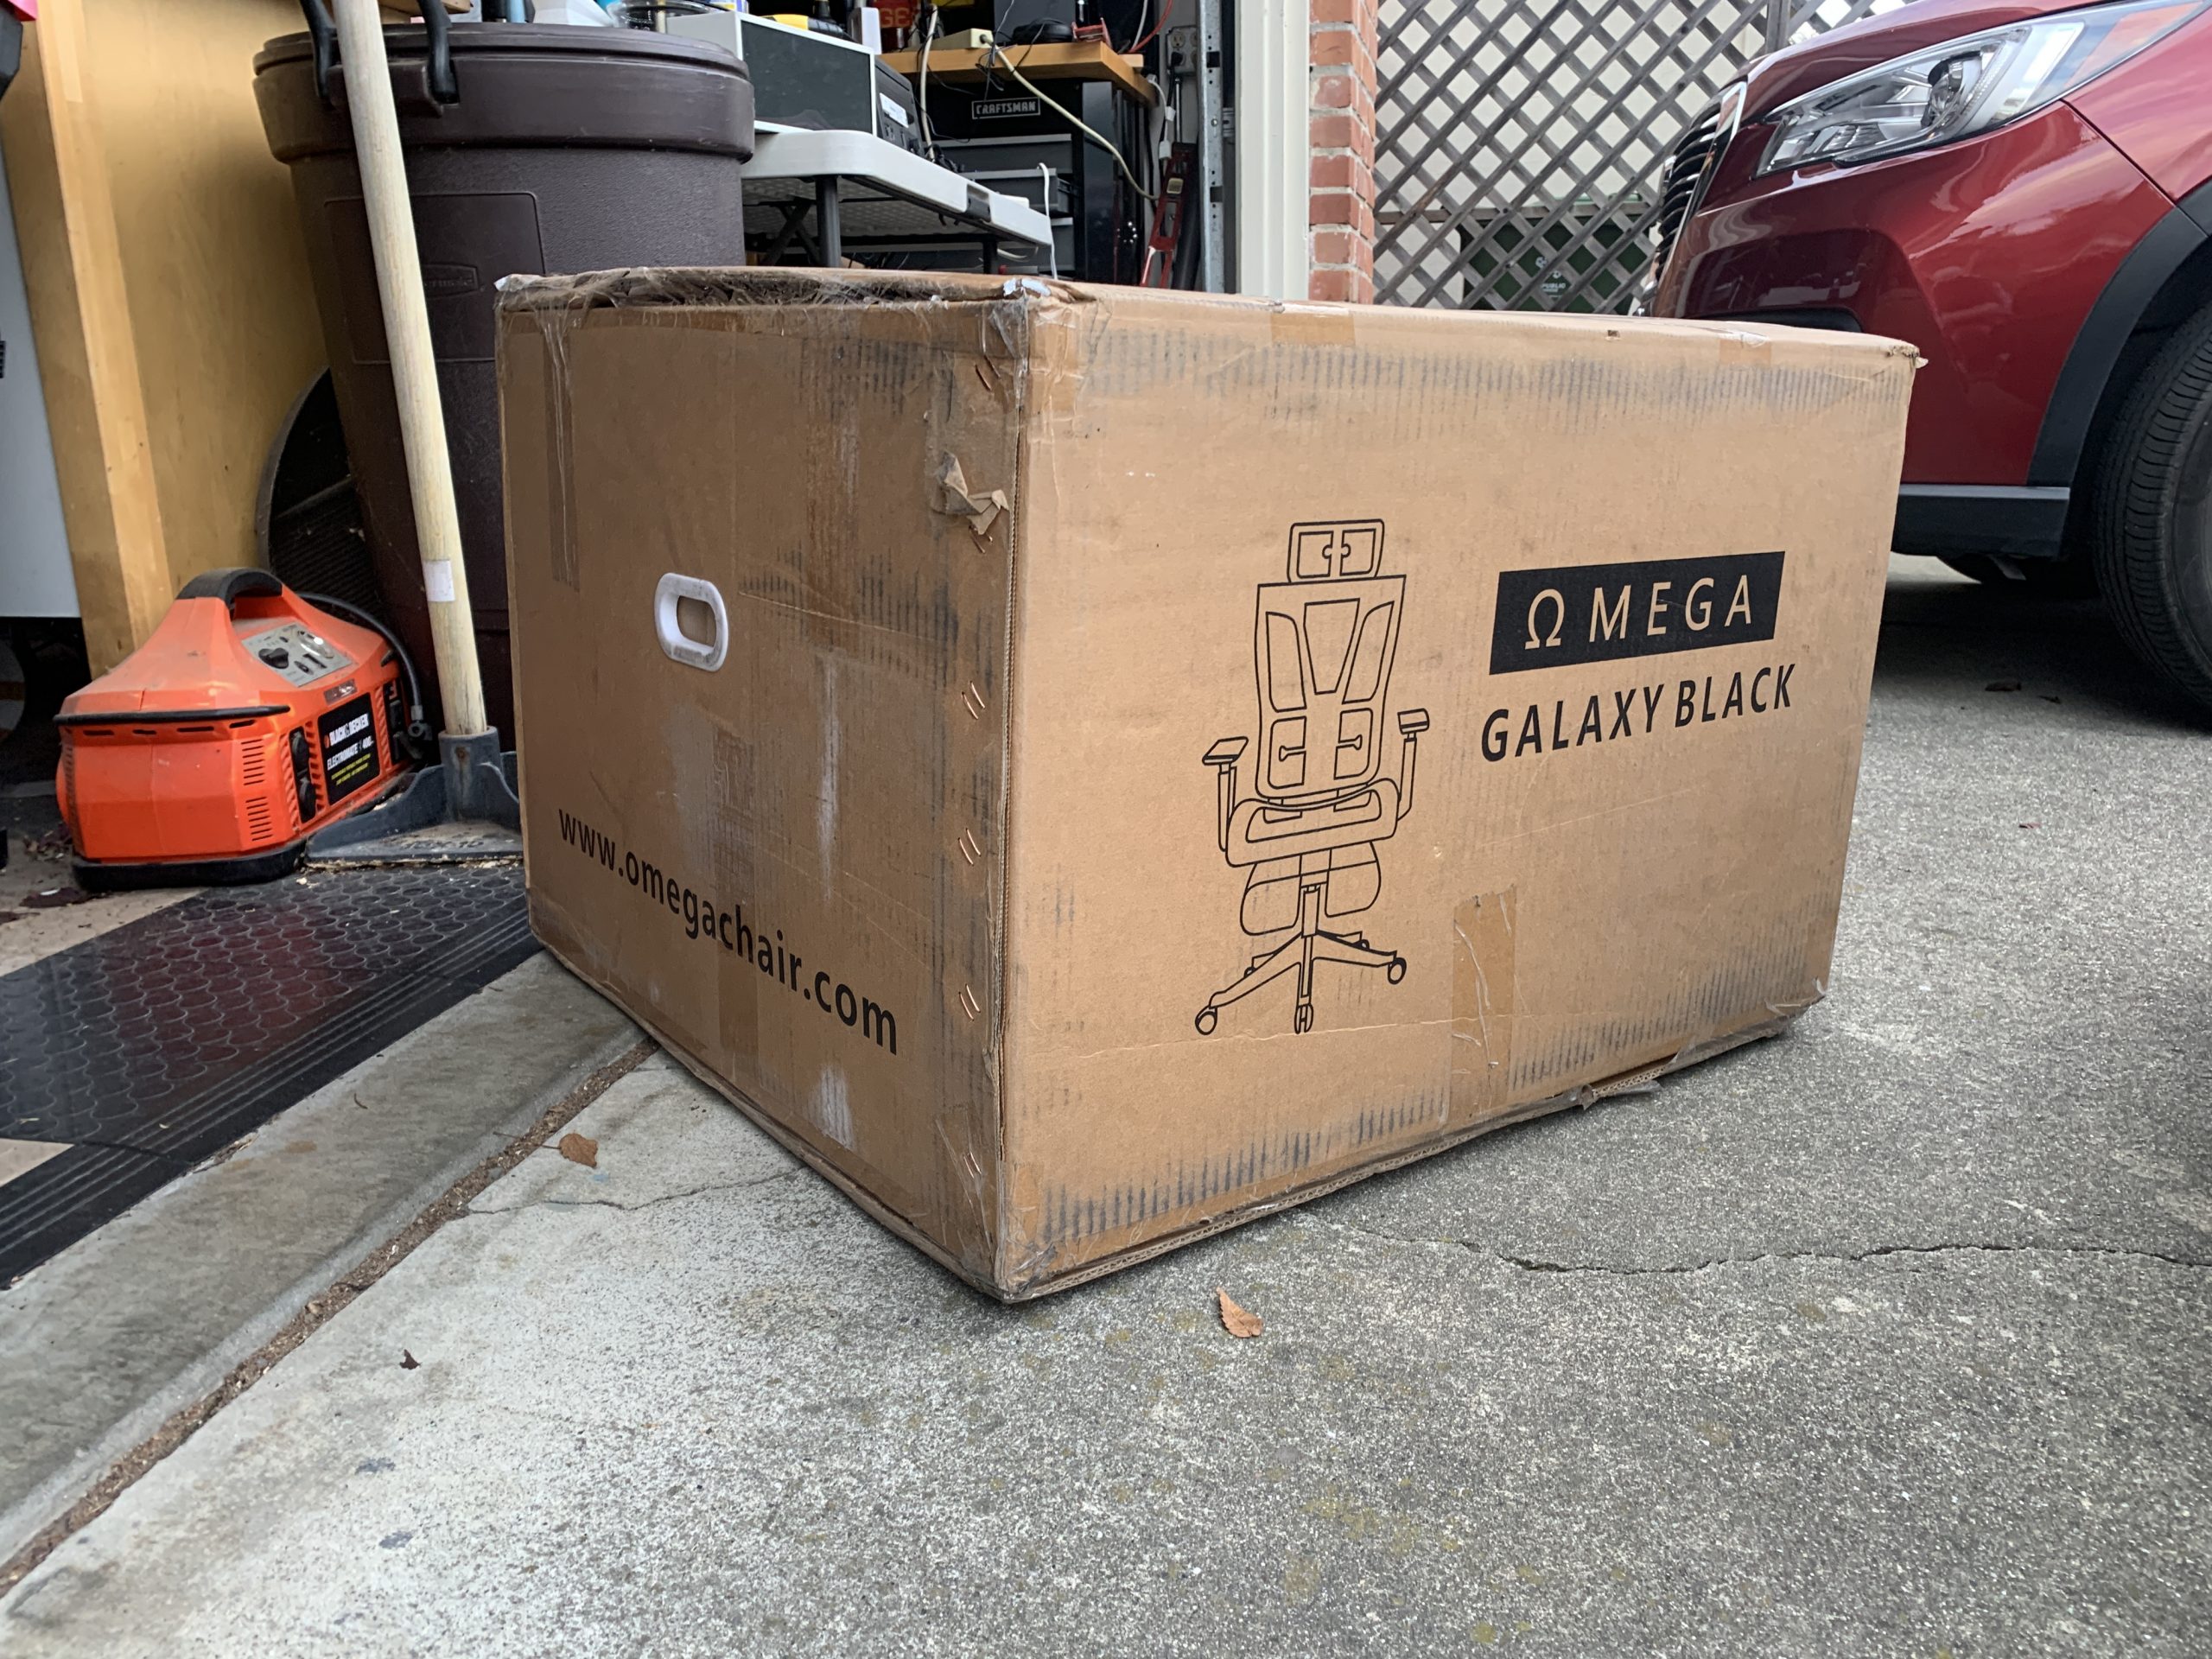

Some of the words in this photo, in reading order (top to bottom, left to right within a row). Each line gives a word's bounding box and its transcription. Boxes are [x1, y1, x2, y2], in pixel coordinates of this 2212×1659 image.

[976, 101, 1036, 114] CRAFTSMAN
[1481, 683, 1664, 762] GALAXY
[1675, 664, 1796, 728] BLACK
[558, 809, 898, 1056] www.omegachair.com
